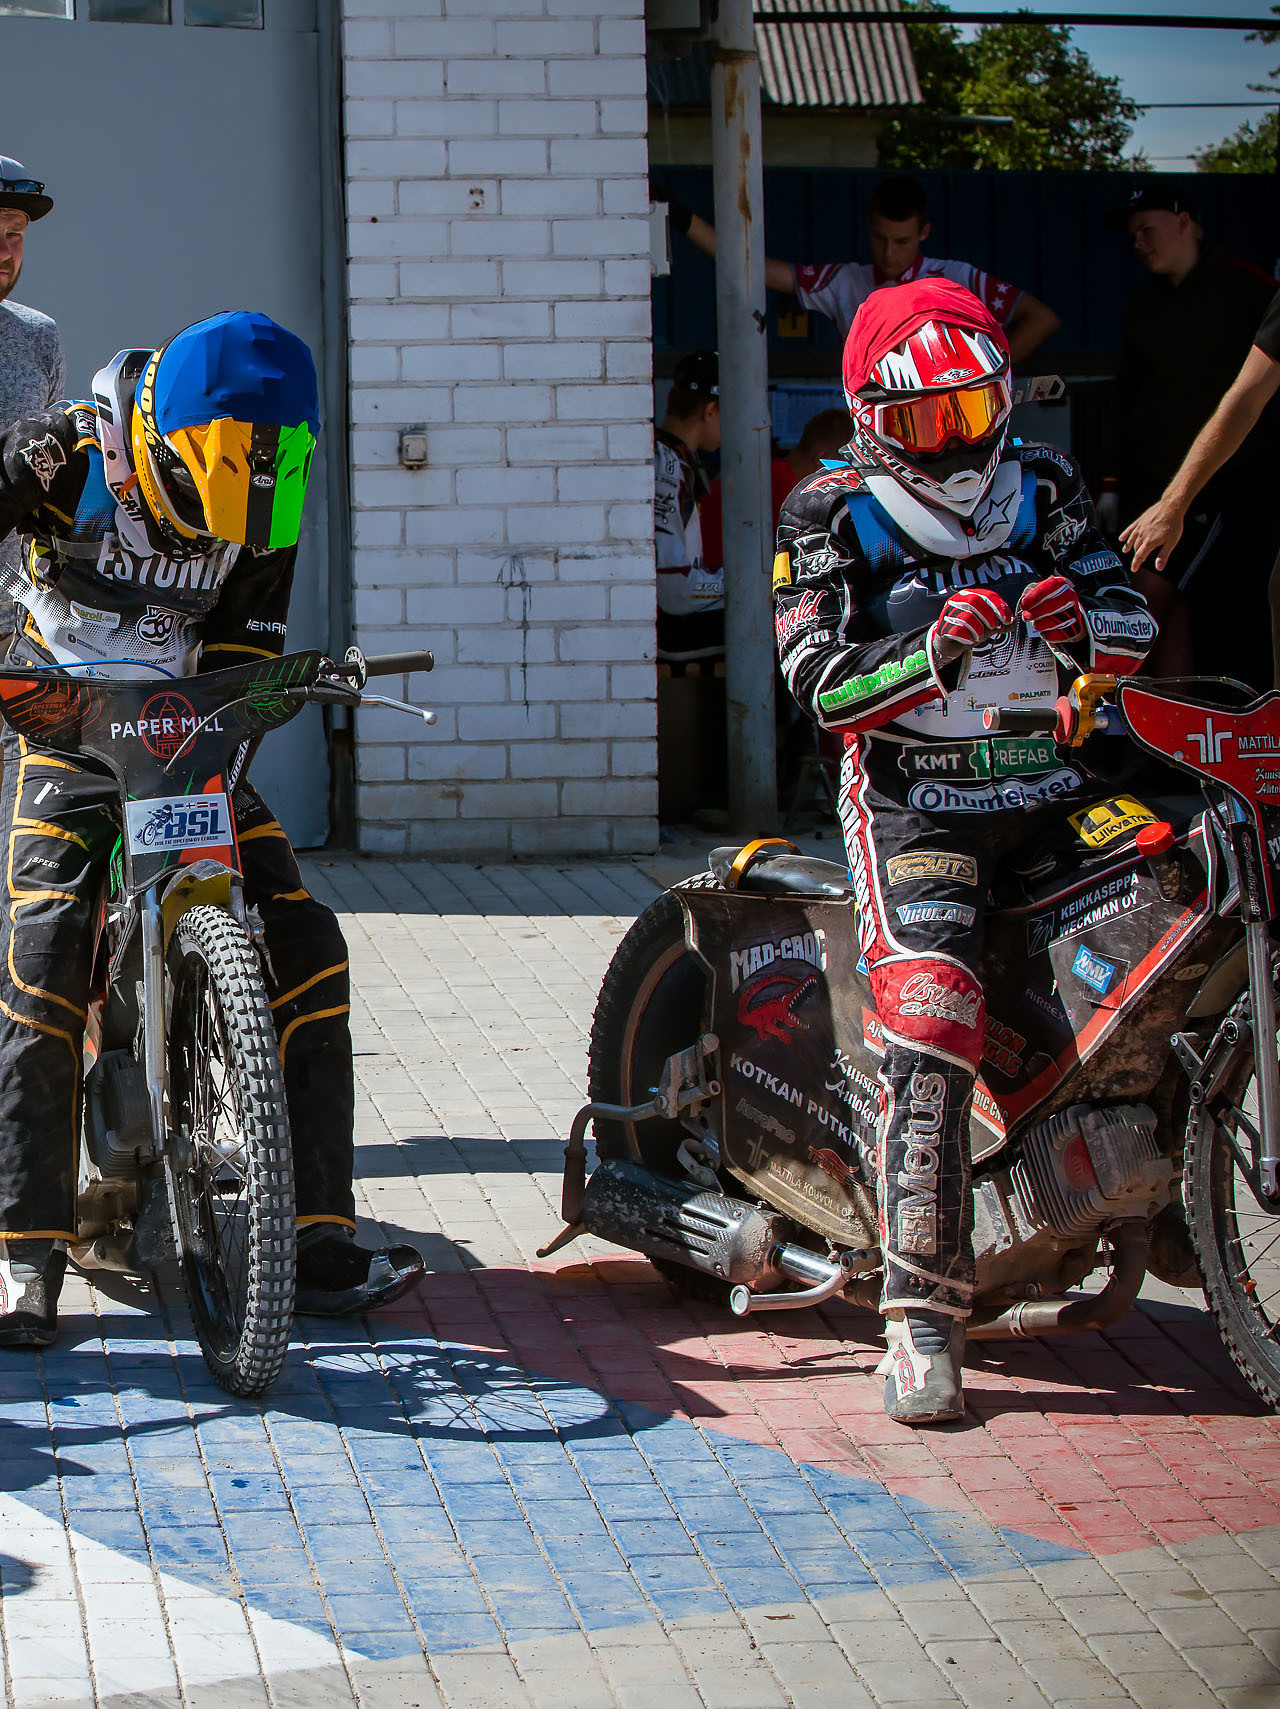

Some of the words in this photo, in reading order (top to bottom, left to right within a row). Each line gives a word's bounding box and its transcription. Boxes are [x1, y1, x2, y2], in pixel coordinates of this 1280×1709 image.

[110, 718, 174, 740] PAPER
[181, 714, 224, 735] MILL
[915, 753, 961, 770] KMT
[164, 809, 227, 840] BSL
[1059, 898, 1119, 938] WECKMAN
[1121, 891, 1139, 909] OY
[1060, 869, 1140, 920] KEIKKASEPPÄ
[730, 928, 827, 995] MAD-CROC
[729, 1052, 804, 1109] KOTKAN
